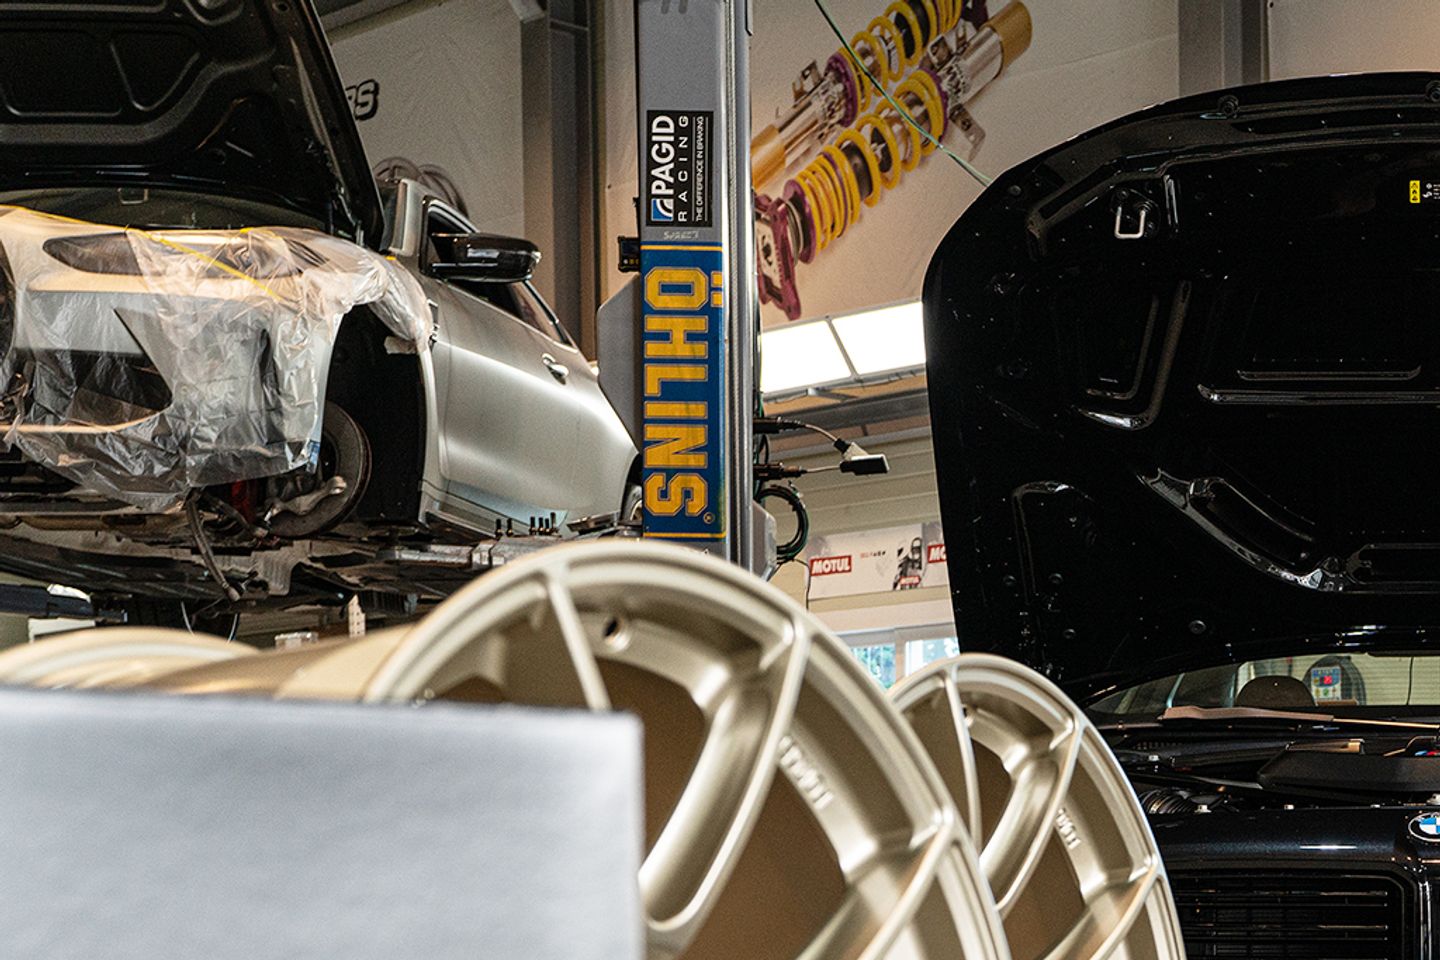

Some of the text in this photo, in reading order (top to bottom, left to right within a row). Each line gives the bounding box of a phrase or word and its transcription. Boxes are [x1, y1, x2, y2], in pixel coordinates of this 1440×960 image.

[651, 115, 675, 195] PAGID
[678, 115, 689, 222] RACING
[696, 116, 704, 222] THE DIFFERENCE IN BRAKING
[644, 265, 724, 518] ÖHLINS
[811, 557, 851, 575] MOTUL
